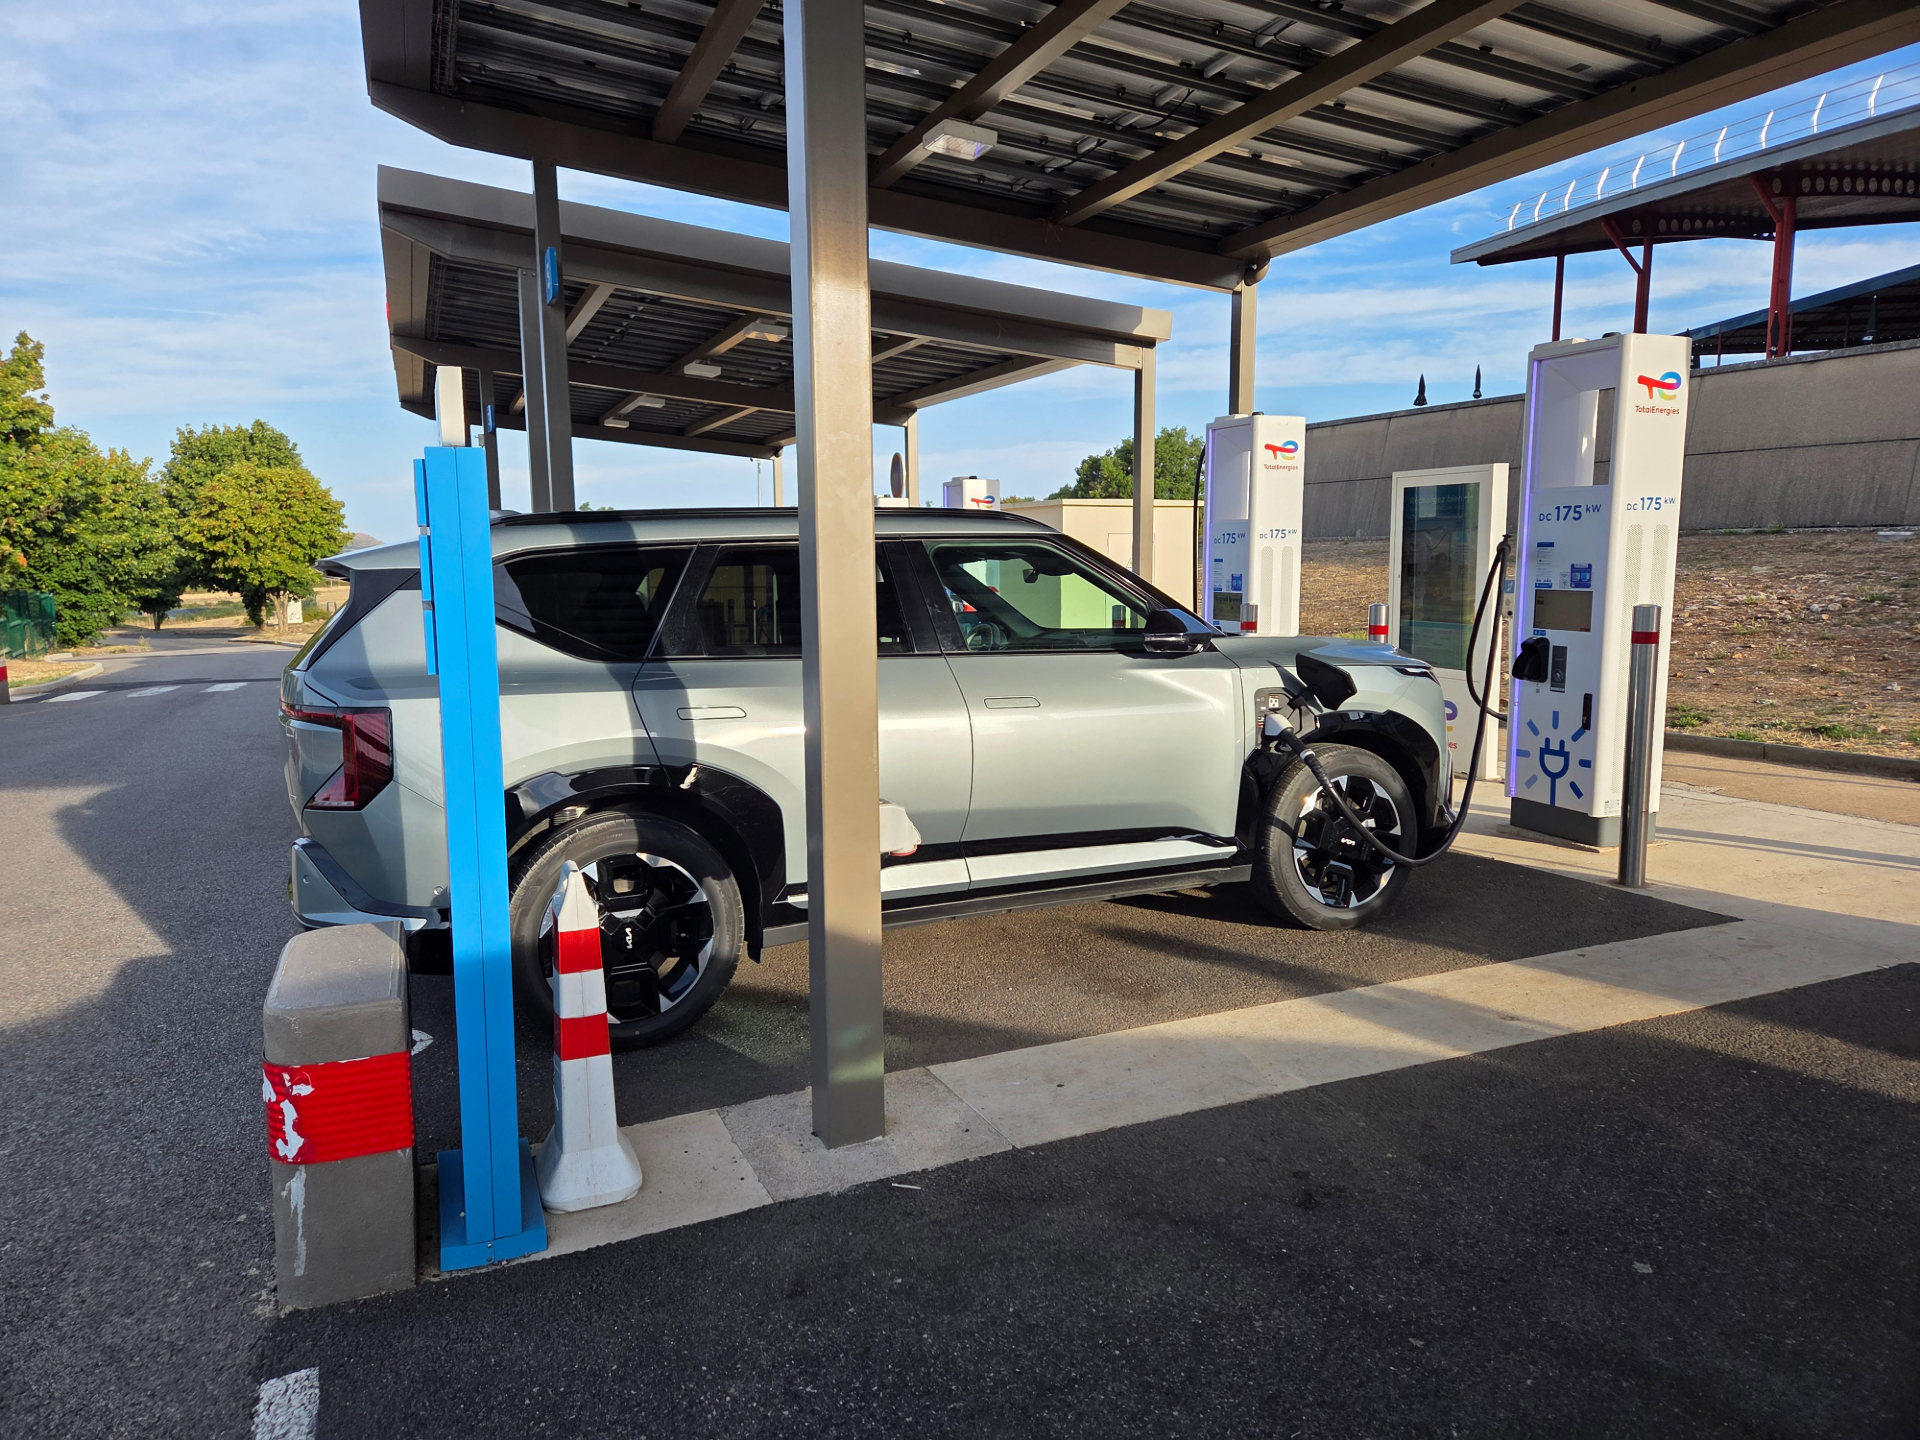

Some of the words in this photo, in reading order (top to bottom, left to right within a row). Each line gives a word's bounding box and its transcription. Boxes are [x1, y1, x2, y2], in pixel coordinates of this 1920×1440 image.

[1635, 405, 1680, 416] TotalEnergies
[1263, 463, 1299, 471] TotalEnergies
[1626, 503, 1638, 511] DC
[1640, 497, 1662, 511] 175
[1539, 513, 1552, 521] DC
[1555, 505, 1582, 521] 175
[1585, 504, 1602, 513] kW
[1221, 533, 1237, 544] 175
[1269, 529, 1287, 539] 175
